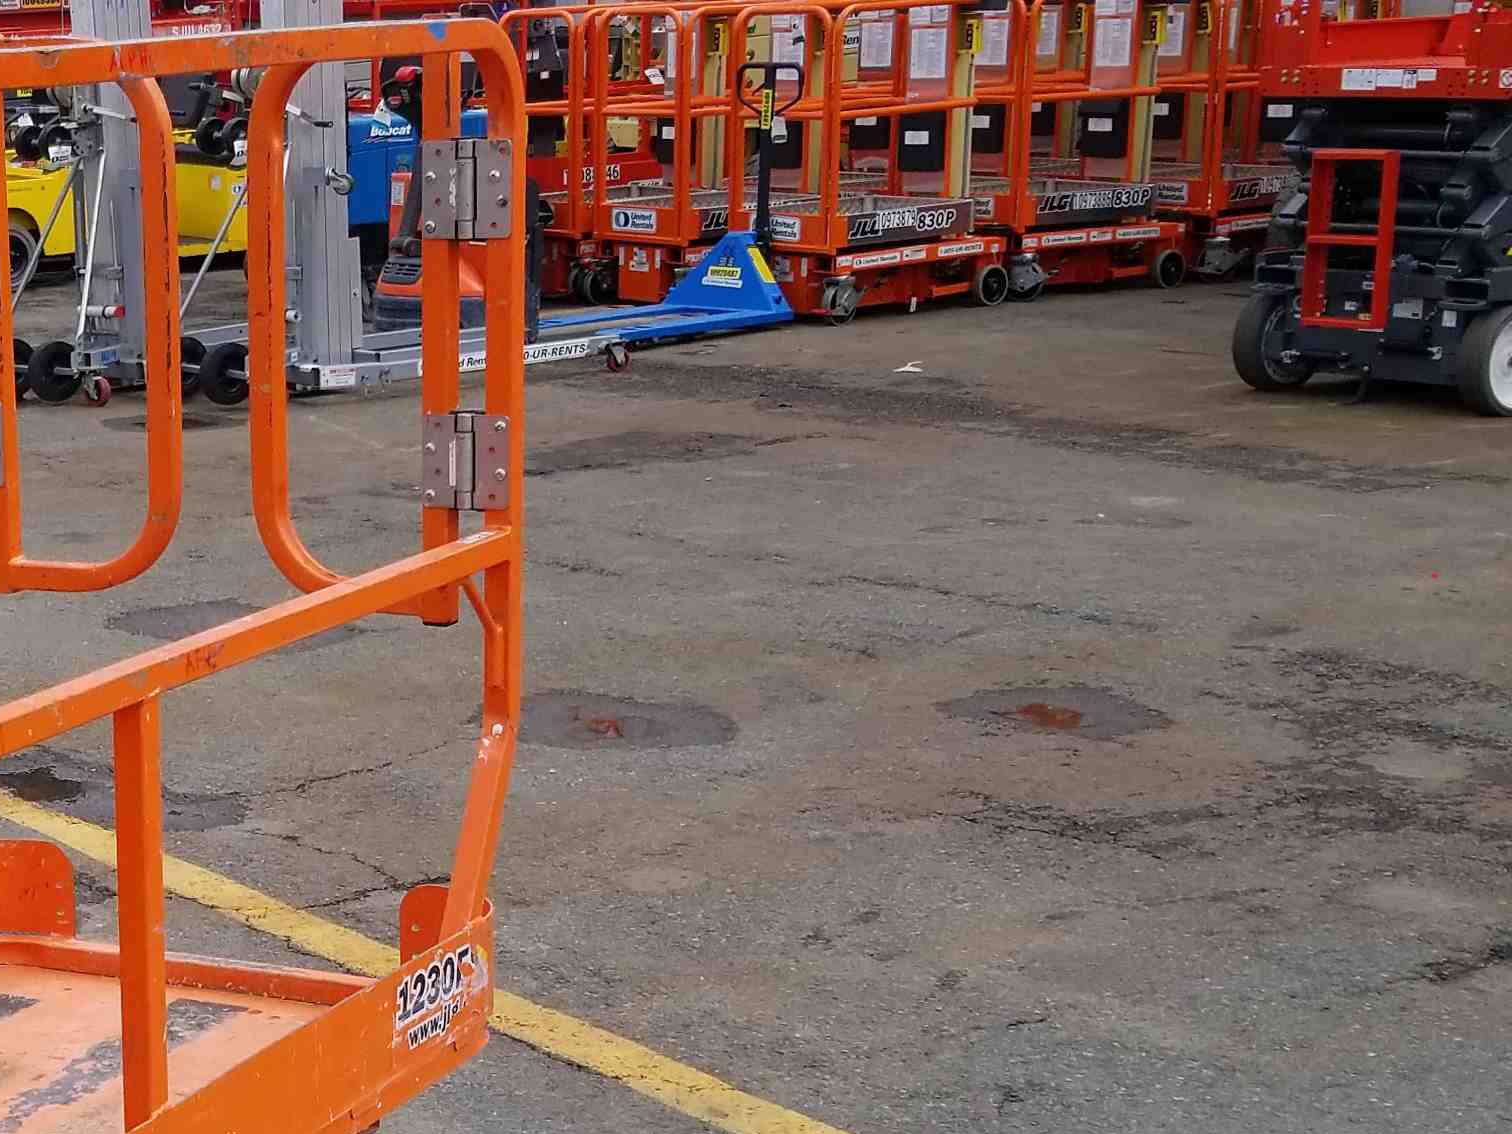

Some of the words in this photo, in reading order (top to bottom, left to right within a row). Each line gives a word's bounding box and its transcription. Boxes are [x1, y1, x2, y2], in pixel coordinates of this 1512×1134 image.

[1038, 193, 1072, 213] JLG
[1112, 187, 1152, 208] 830P
[916, 208, 957, 232] 830P
